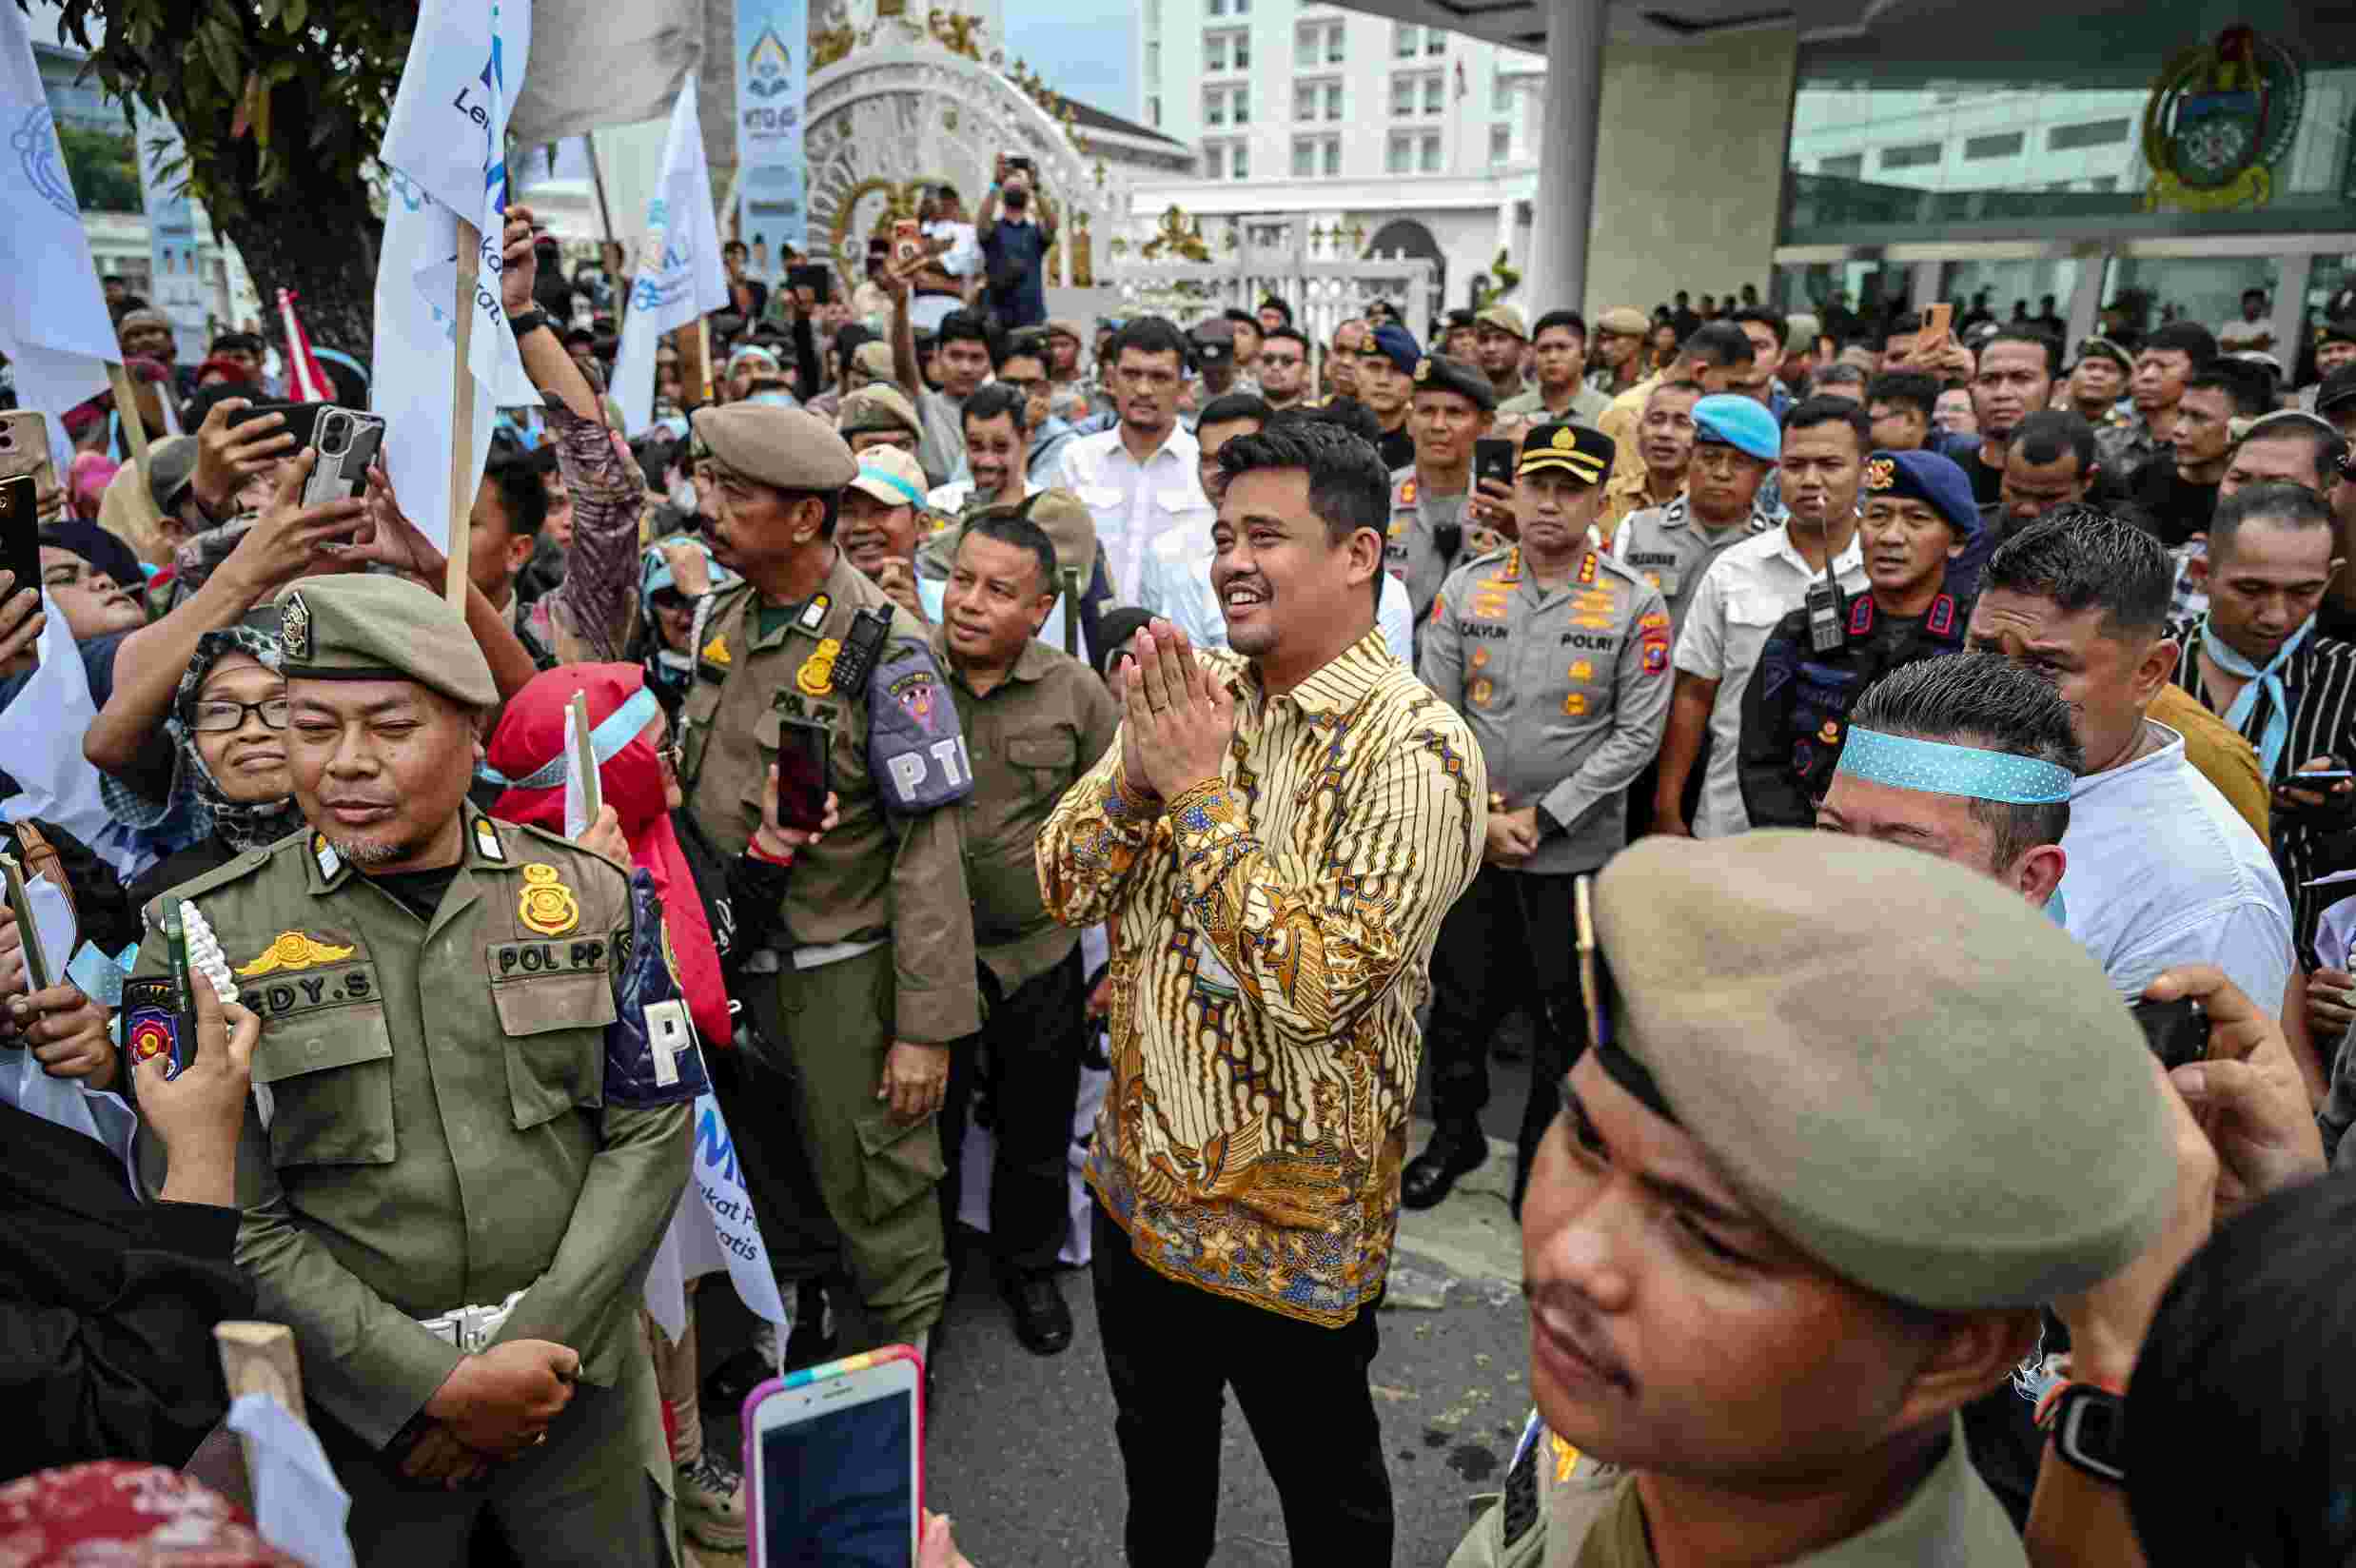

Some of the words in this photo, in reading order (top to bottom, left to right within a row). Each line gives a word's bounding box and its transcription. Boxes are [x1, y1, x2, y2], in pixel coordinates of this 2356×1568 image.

[1561, 633, 1613, 652] POLRI
[499, 944, 560, 974] POL
[570, 940, 604, 970] PP
[701, 1186, 740, 1222] kat
